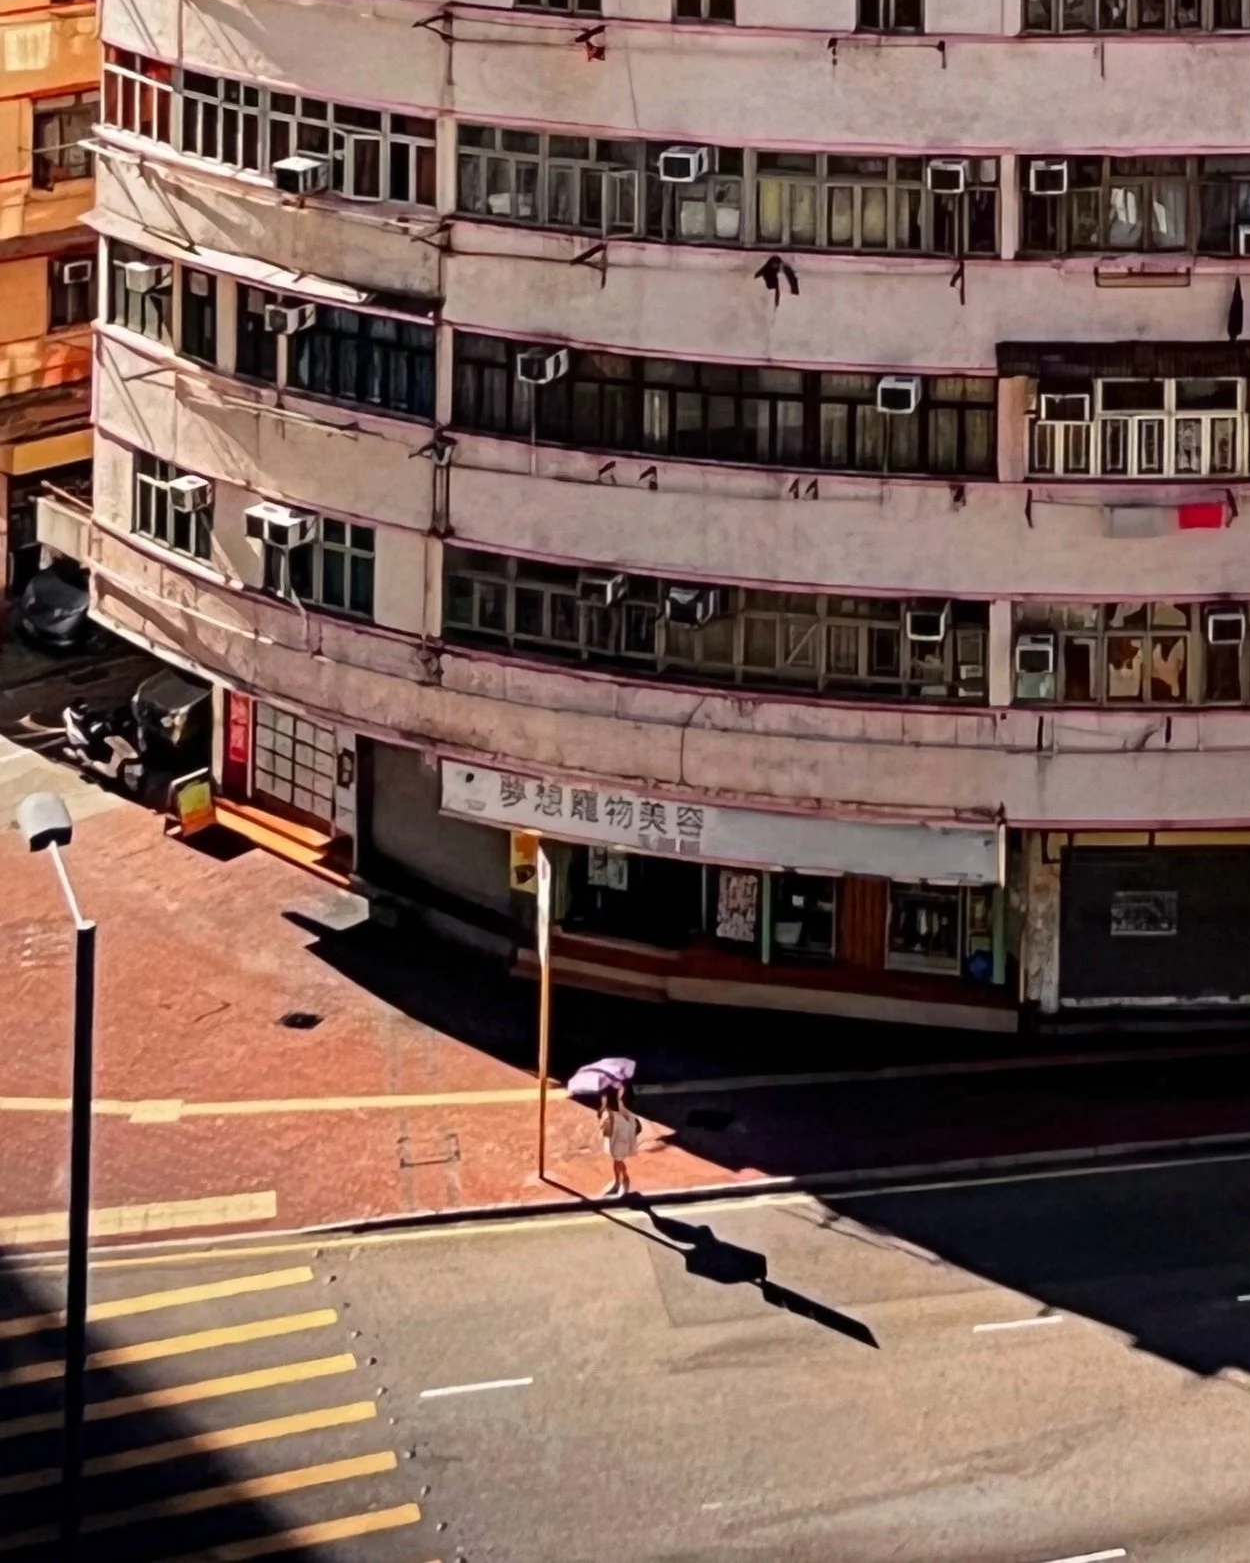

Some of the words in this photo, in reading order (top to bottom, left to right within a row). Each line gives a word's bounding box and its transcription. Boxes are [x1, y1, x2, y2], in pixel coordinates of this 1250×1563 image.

[500, 774, 704, 837] 夢想寵物美容
